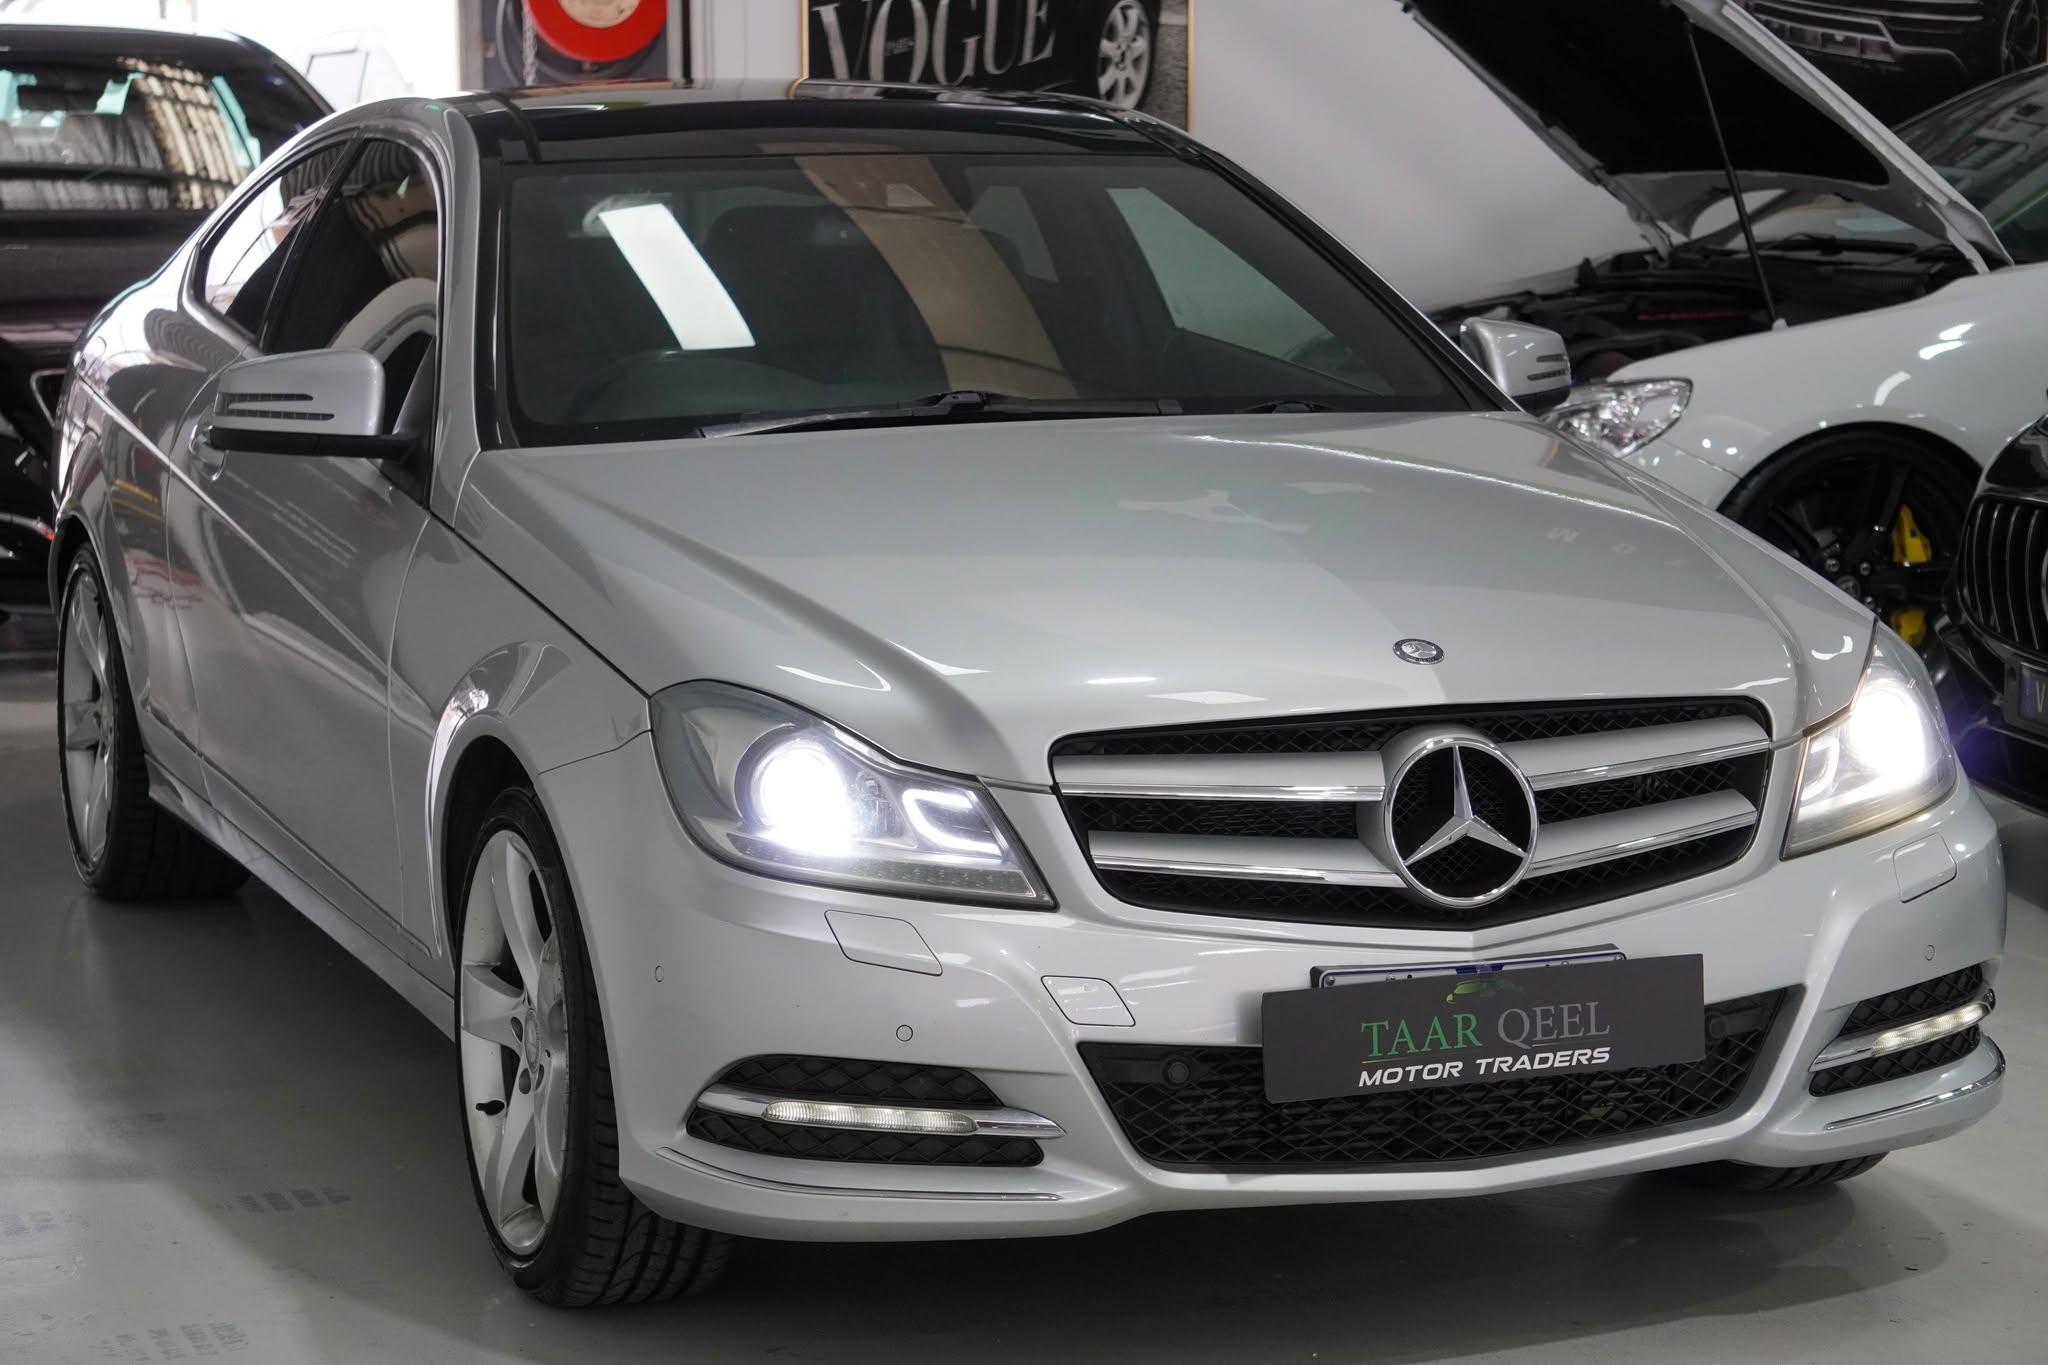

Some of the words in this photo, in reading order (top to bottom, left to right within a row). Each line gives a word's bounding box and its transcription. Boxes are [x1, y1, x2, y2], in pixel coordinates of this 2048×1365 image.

[810, 0, 1056, 86] VOGUE
[1361, 1013, 1483, 1057] TAAR
[1497, 1001, 1610, 1050] QEEL
[1358, 1061, 1464, 1087] MOTOR
[1475, 1046, 1611, 1075] TRADERS
